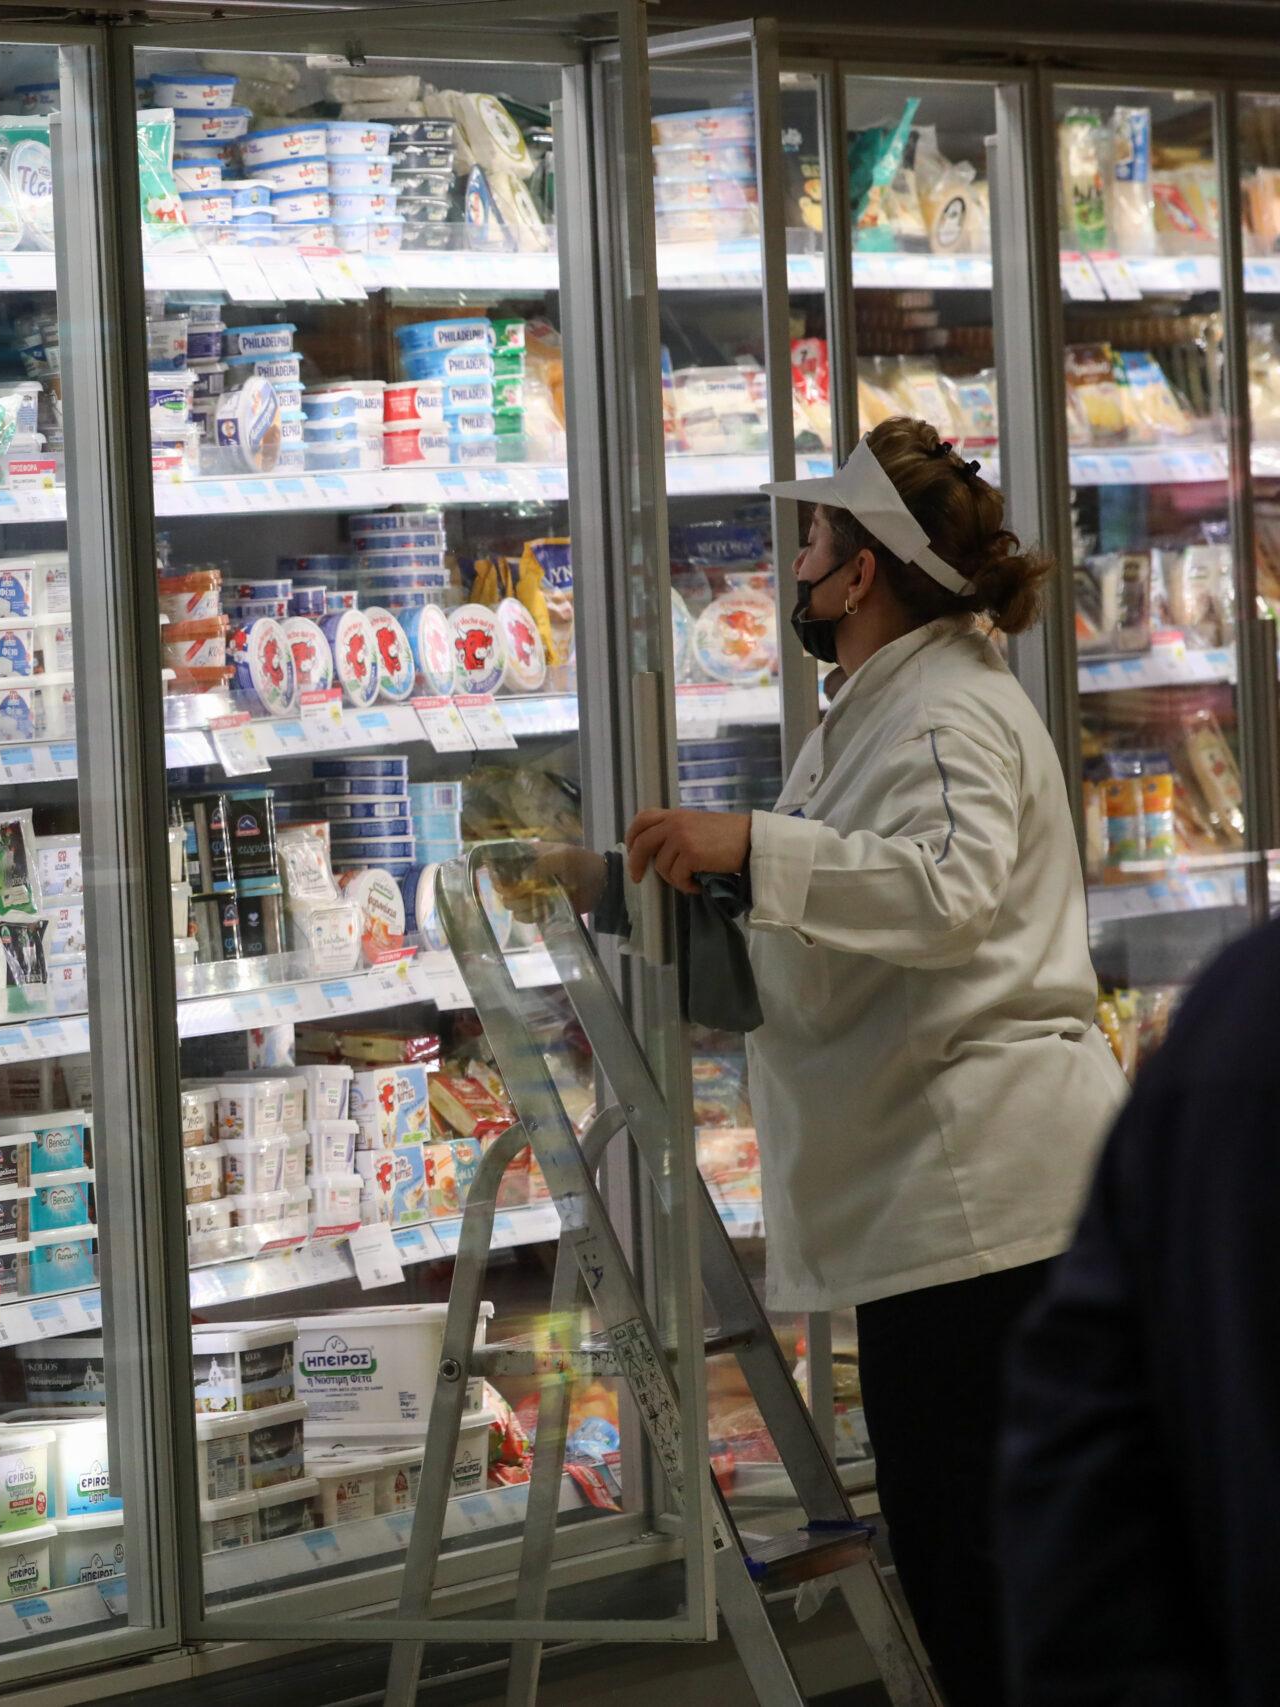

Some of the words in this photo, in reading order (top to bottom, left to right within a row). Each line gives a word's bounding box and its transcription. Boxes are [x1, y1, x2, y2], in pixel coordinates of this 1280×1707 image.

[48, 1136, 70, 1148] Benecol
[307, 1354, 369, 1368] ΗΠΕΙΡΟΣ
[8, 1470, 35, 1484] EPIROS
[9, 1567, 36, 1580] ΗΠΕΙΡΟΣ
